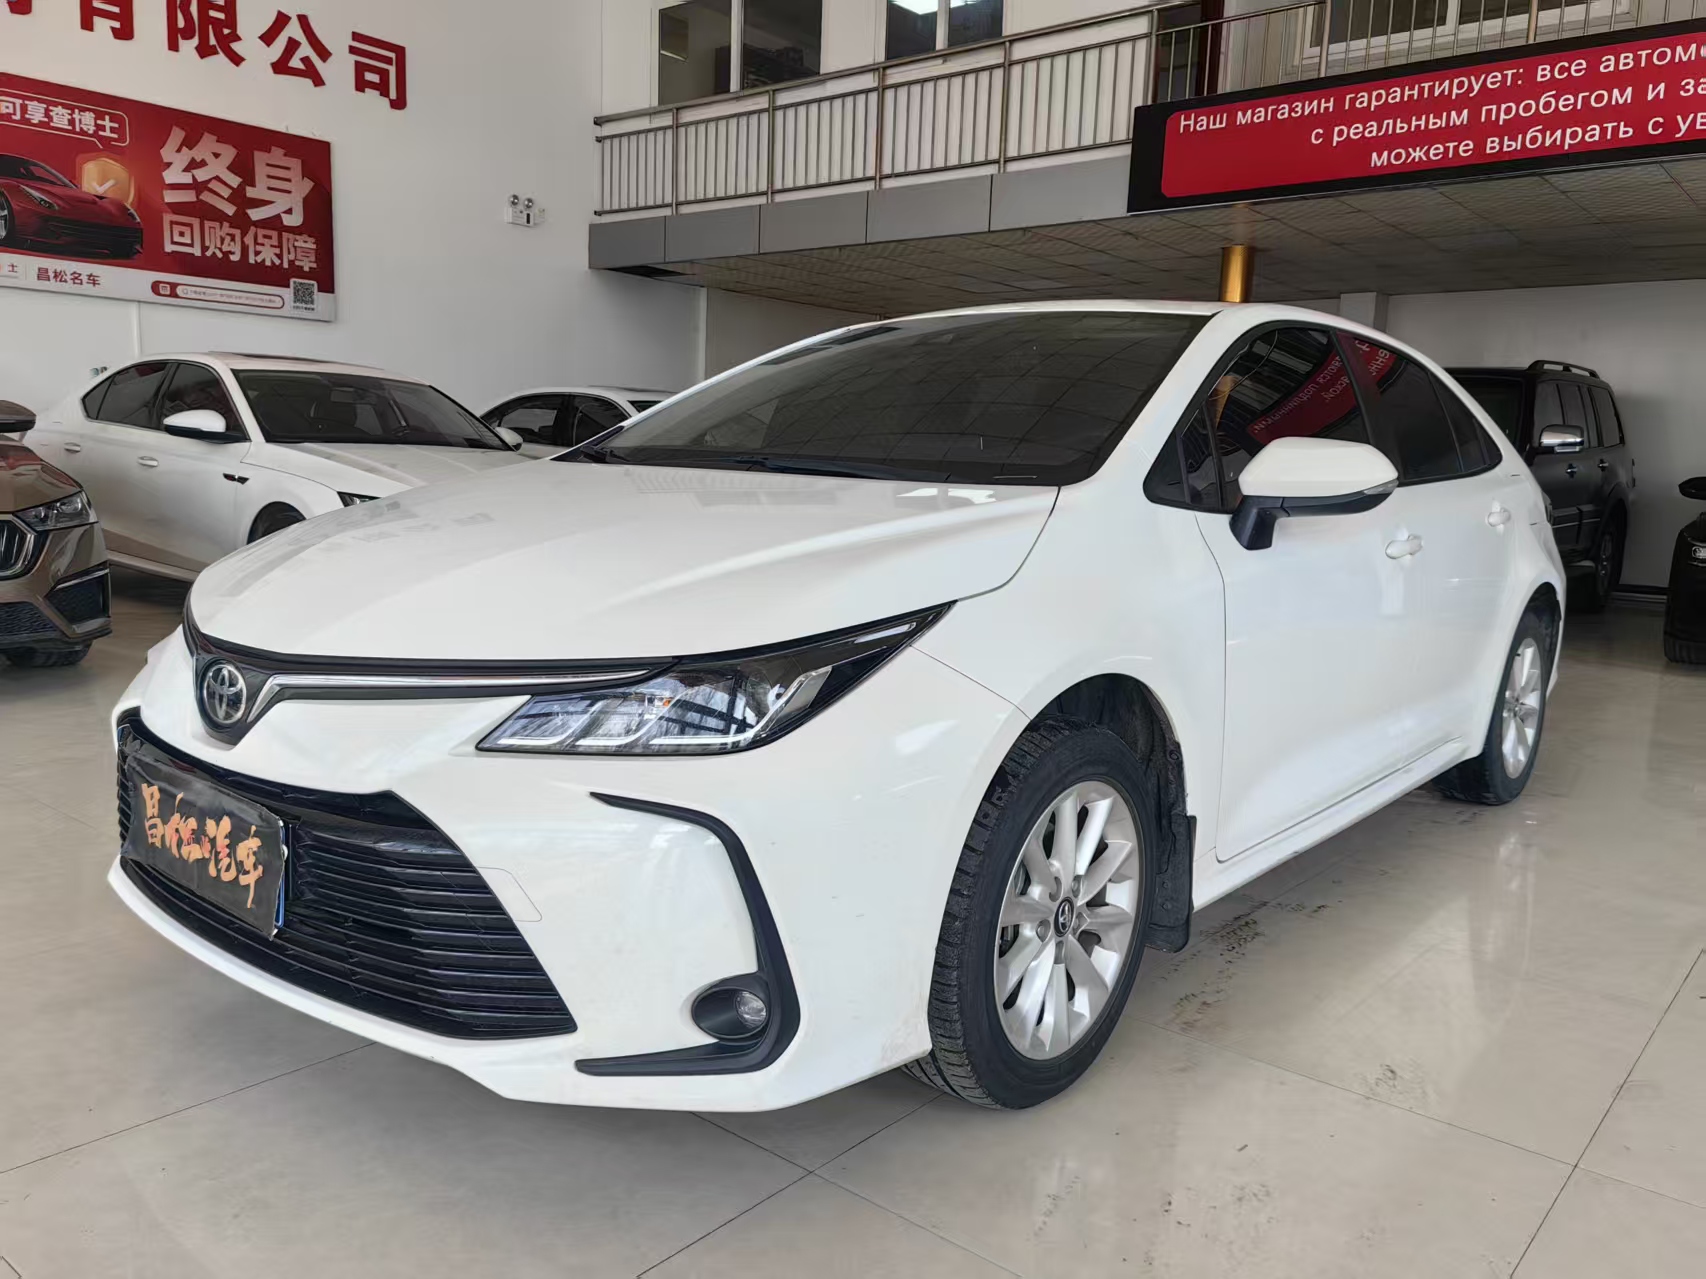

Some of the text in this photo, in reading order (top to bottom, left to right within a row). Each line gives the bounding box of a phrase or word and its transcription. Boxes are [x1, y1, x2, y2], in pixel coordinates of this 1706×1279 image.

[1179, 113, 1227, 134] Наш
[1236, 96, 1334, 126] магазин
[1344, 67, 1523, 111] гарантирует:
[1536, 58, 1587, 82] все
[1310, 128, 1323, 144] с
[1332, 108, 1468, 147] реальным
[1480, 86, 1633, 126] пробегом
[1647, 82, 1666, 101] и
[1370, 139, 1474, 168] можете
[1485, 120, 1634, 154] выбирать
[1647, 116, 1664, 135] с
[160, 125, 315, 227] 终身
[162, 213, 317, 272] 回购保障
[37, 266, 101, 287] 昌松名车
